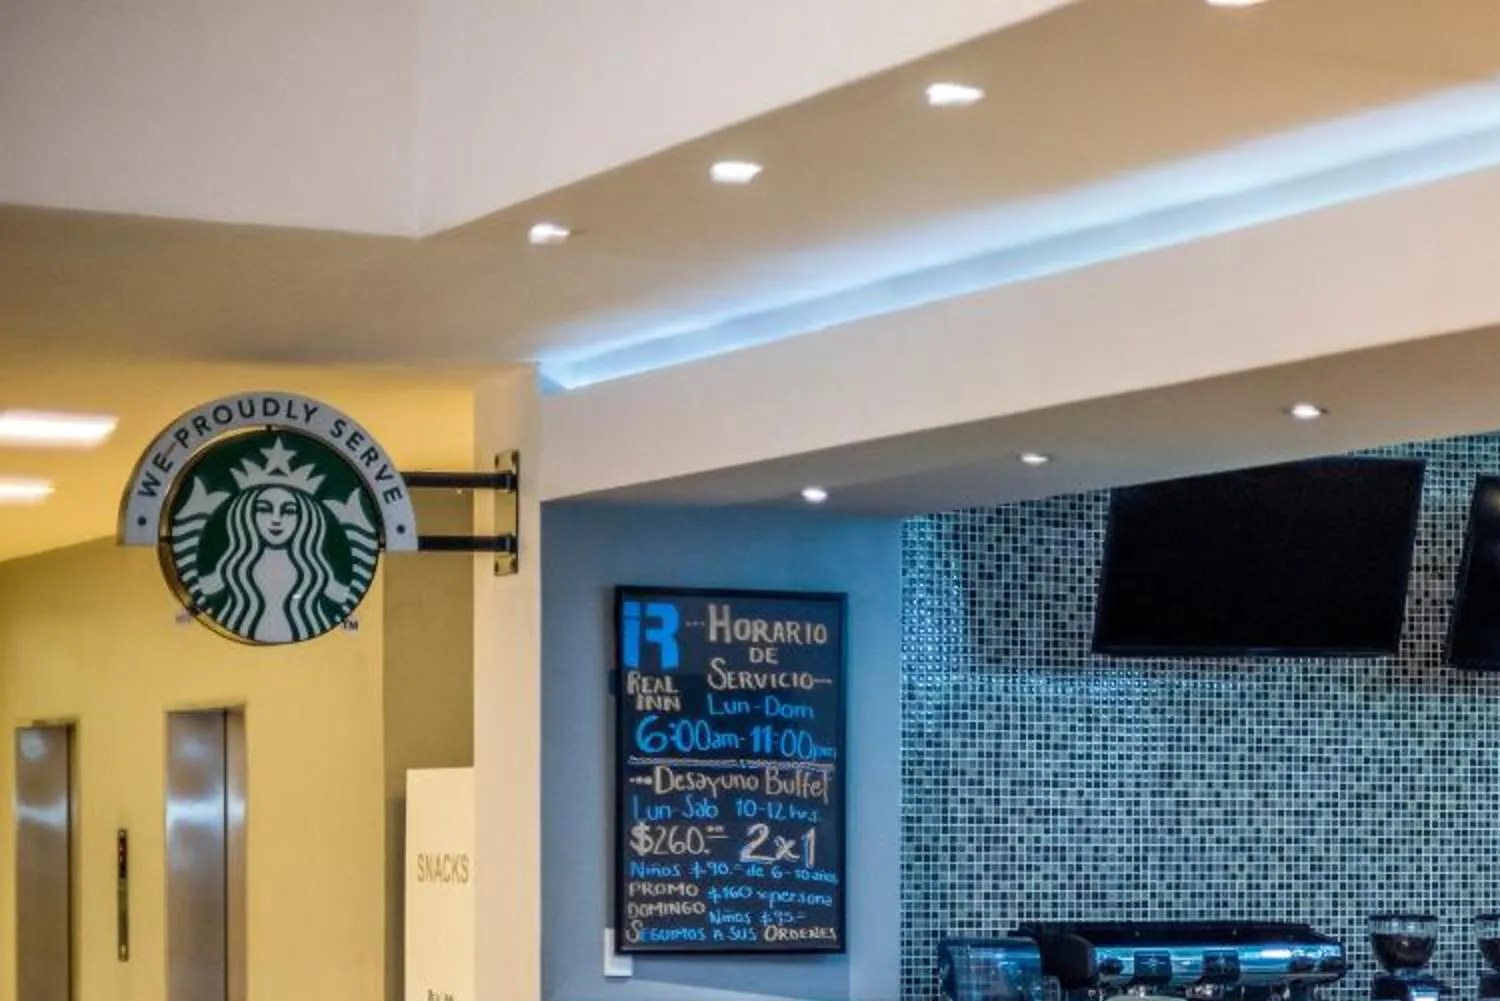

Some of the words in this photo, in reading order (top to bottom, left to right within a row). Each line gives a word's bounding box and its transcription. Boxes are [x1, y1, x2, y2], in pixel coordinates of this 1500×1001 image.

[137, 452, 174, 498] WE
[174, 397, 319, 449] PROUDLY
[329, 418, 404, 504] SERVE
[708, 603, 828, 645] HORARIO
[749, 647, 779, 665] DE
[626, 671, 680, 695] REAL
[636, 694, 681, 711] INN
[654, 764, 759, 798] Desayuno
[417, 852, 470, 884] SNACKS
[628, 882, 700, 898] PROMO
[626, 900, 706, 919] DOMINGO
